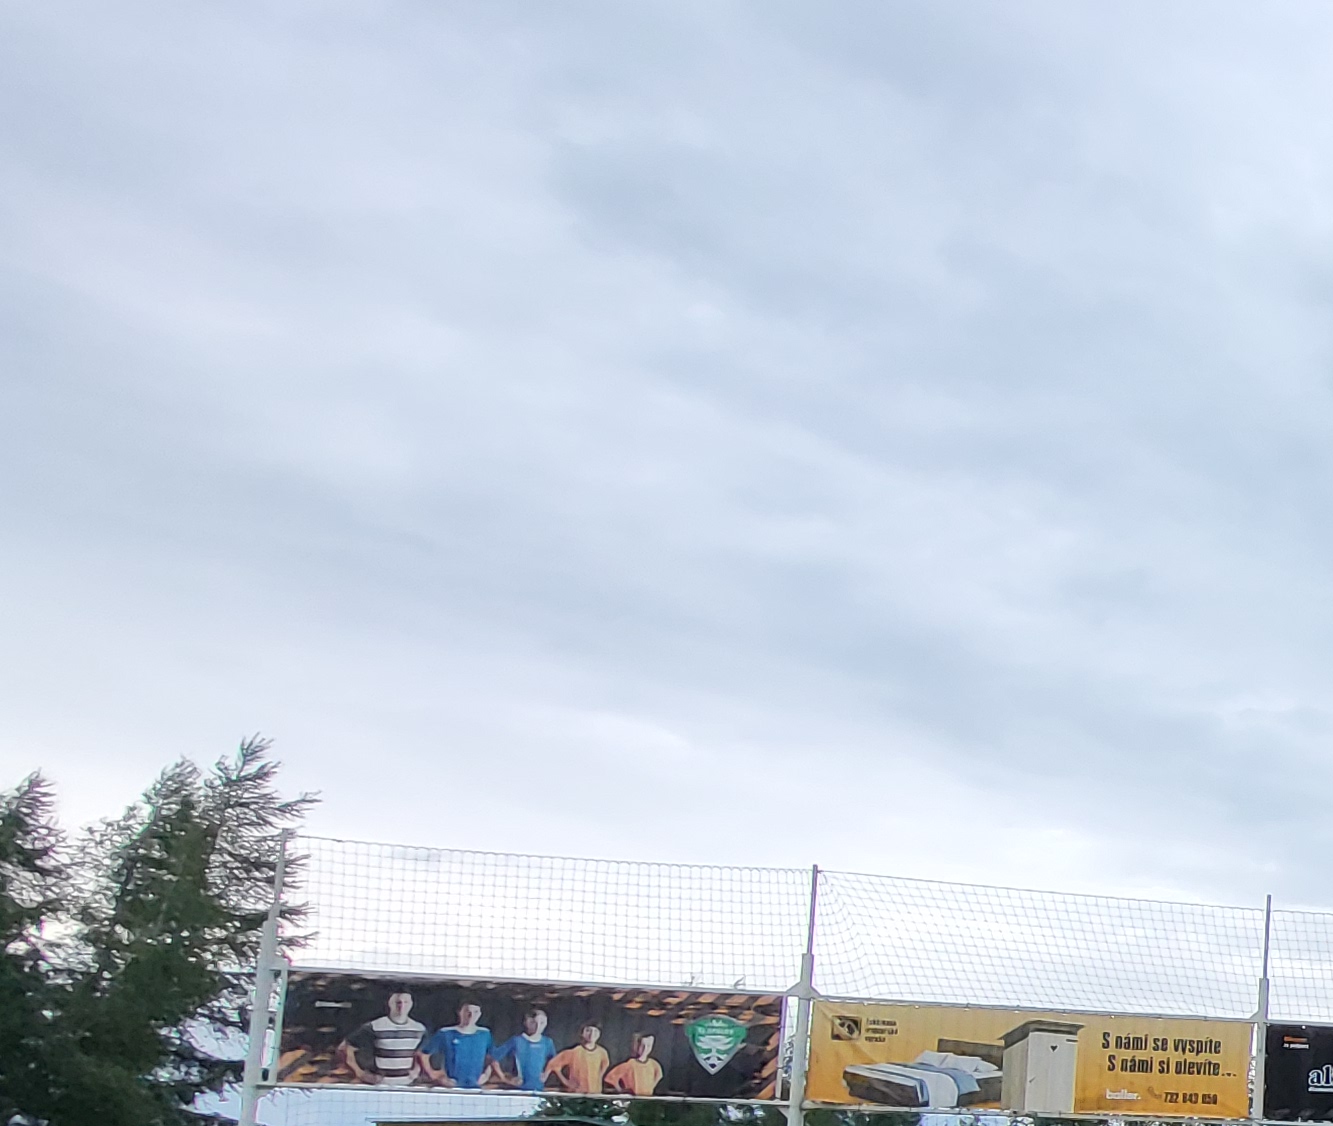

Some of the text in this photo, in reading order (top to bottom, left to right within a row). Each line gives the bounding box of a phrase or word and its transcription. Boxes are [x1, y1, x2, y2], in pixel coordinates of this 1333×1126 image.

[1101, 1031, 1111, 1050] S
[1152, 1037, 1168, 1052] se
[1173, 1036, 1222, 1056] vyspíte
[1107, 1054, 1116, 1072] S
[1120, 1055, 1153, 1074] námi
[1158, 1057, 1170, 1075] si
